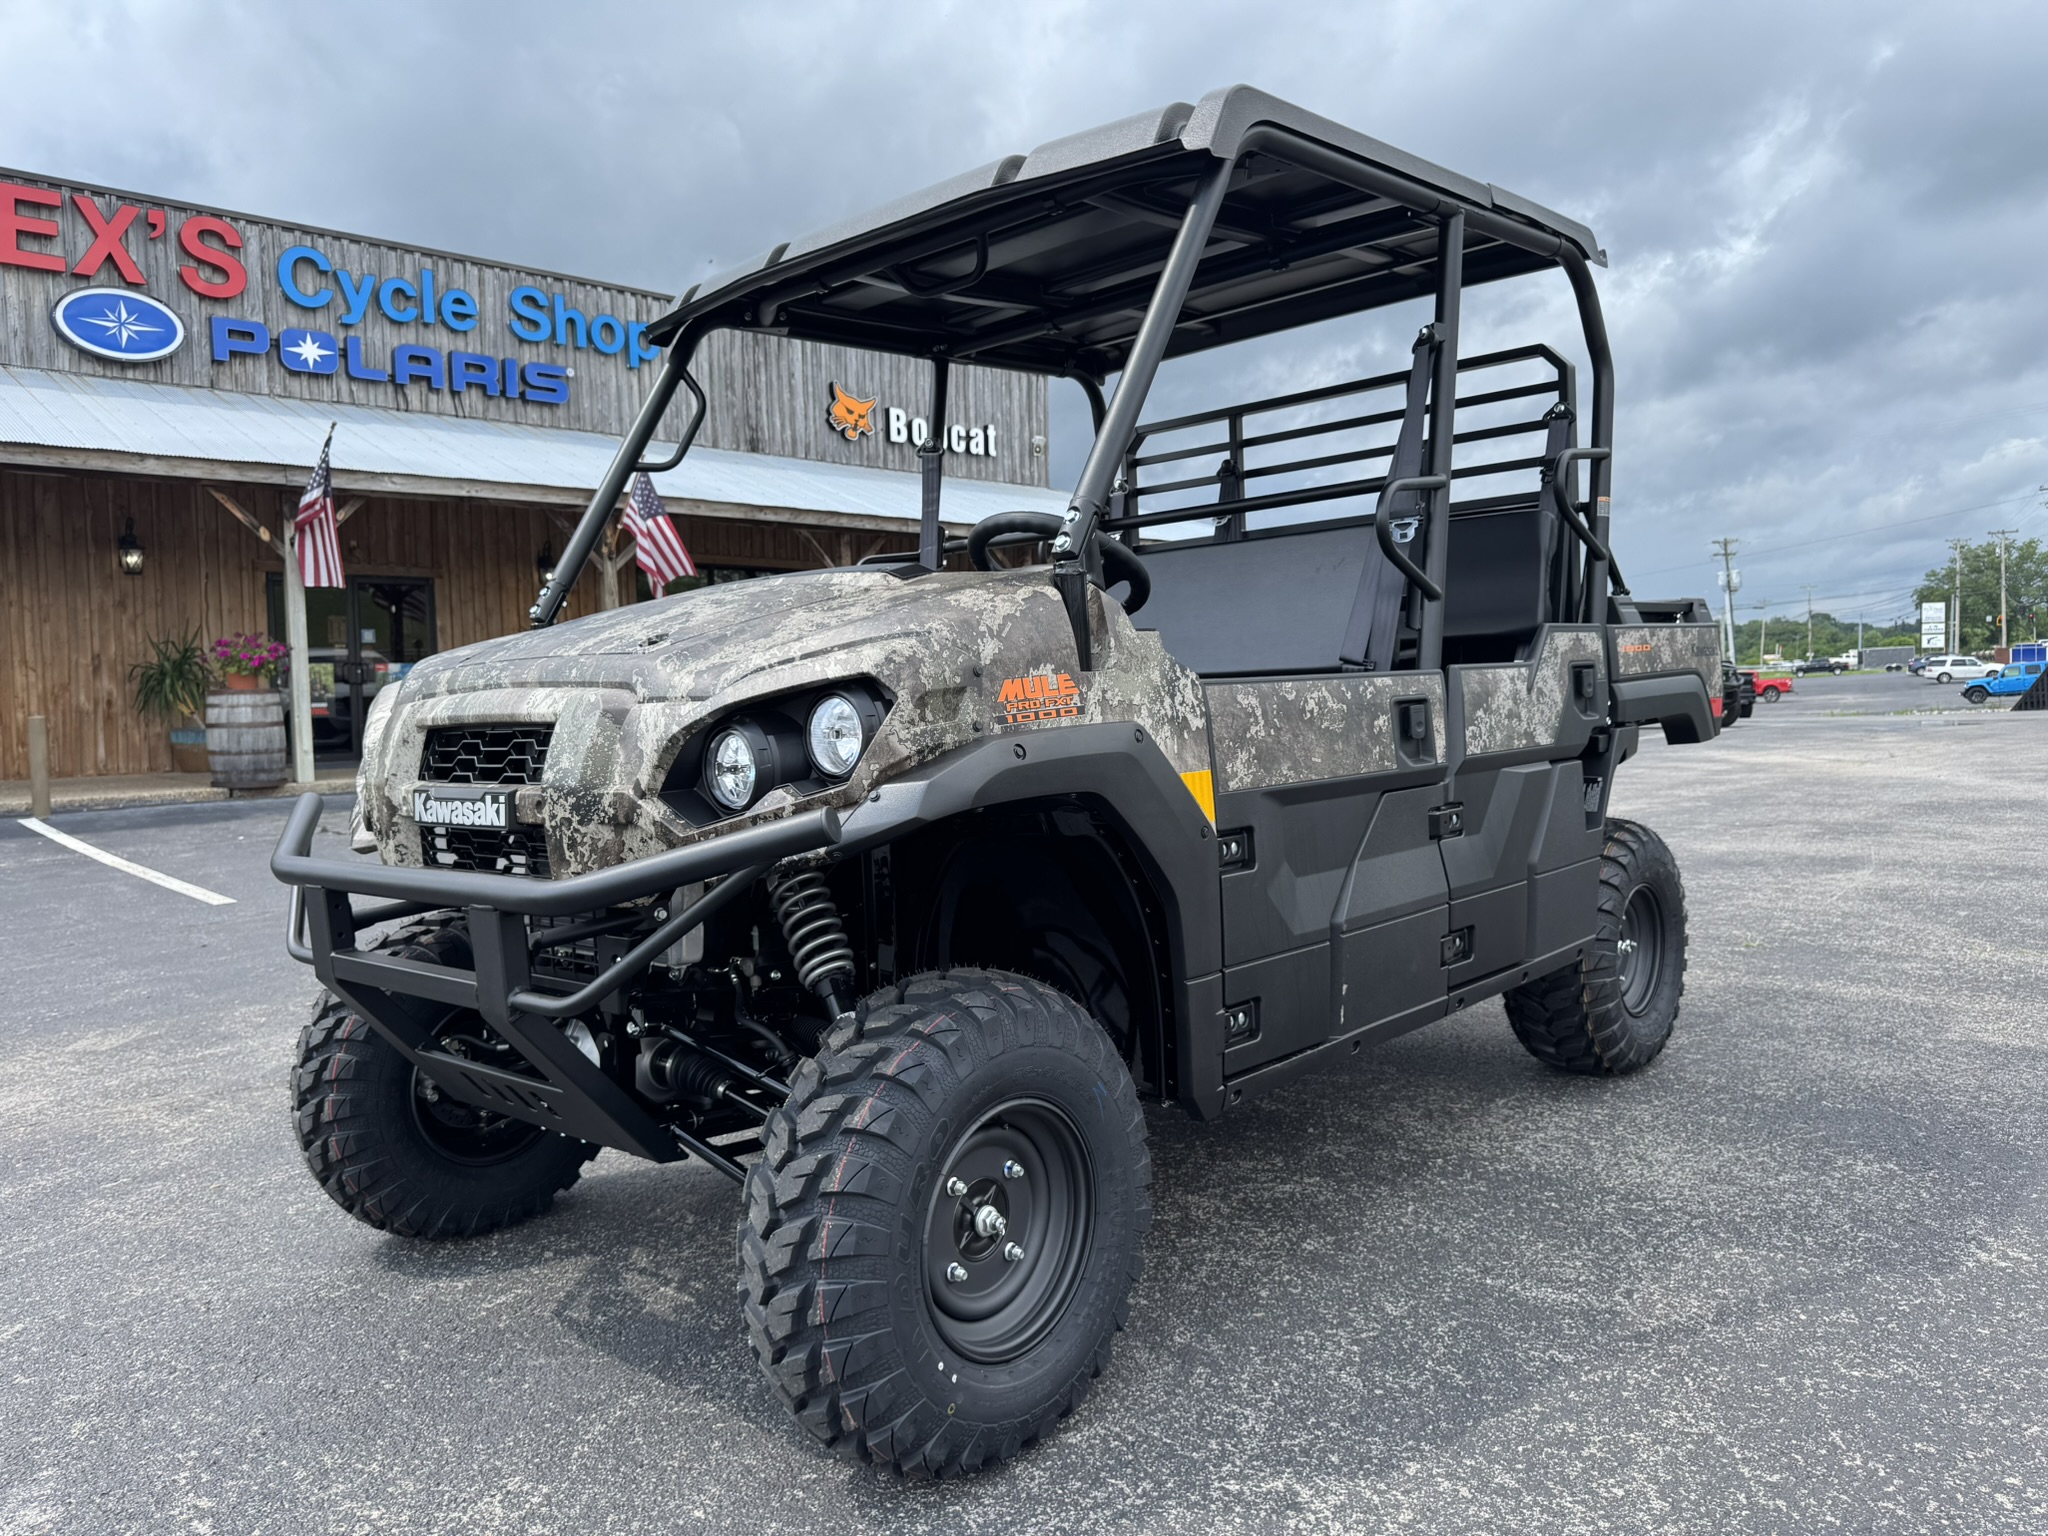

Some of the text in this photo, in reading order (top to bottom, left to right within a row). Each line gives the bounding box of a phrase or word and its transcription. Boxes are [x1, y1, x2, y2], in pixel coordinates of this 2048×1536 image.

[277, 245, 479, 332] Cycle
[510, 285, 662, 369] Shop
[888, 406, 997, 458] Bocat
[998, 674, 1080, 702] MULE
[1006, 707, 1078, 724] 1000
[414, 792, 507, 827] Kawasaki
